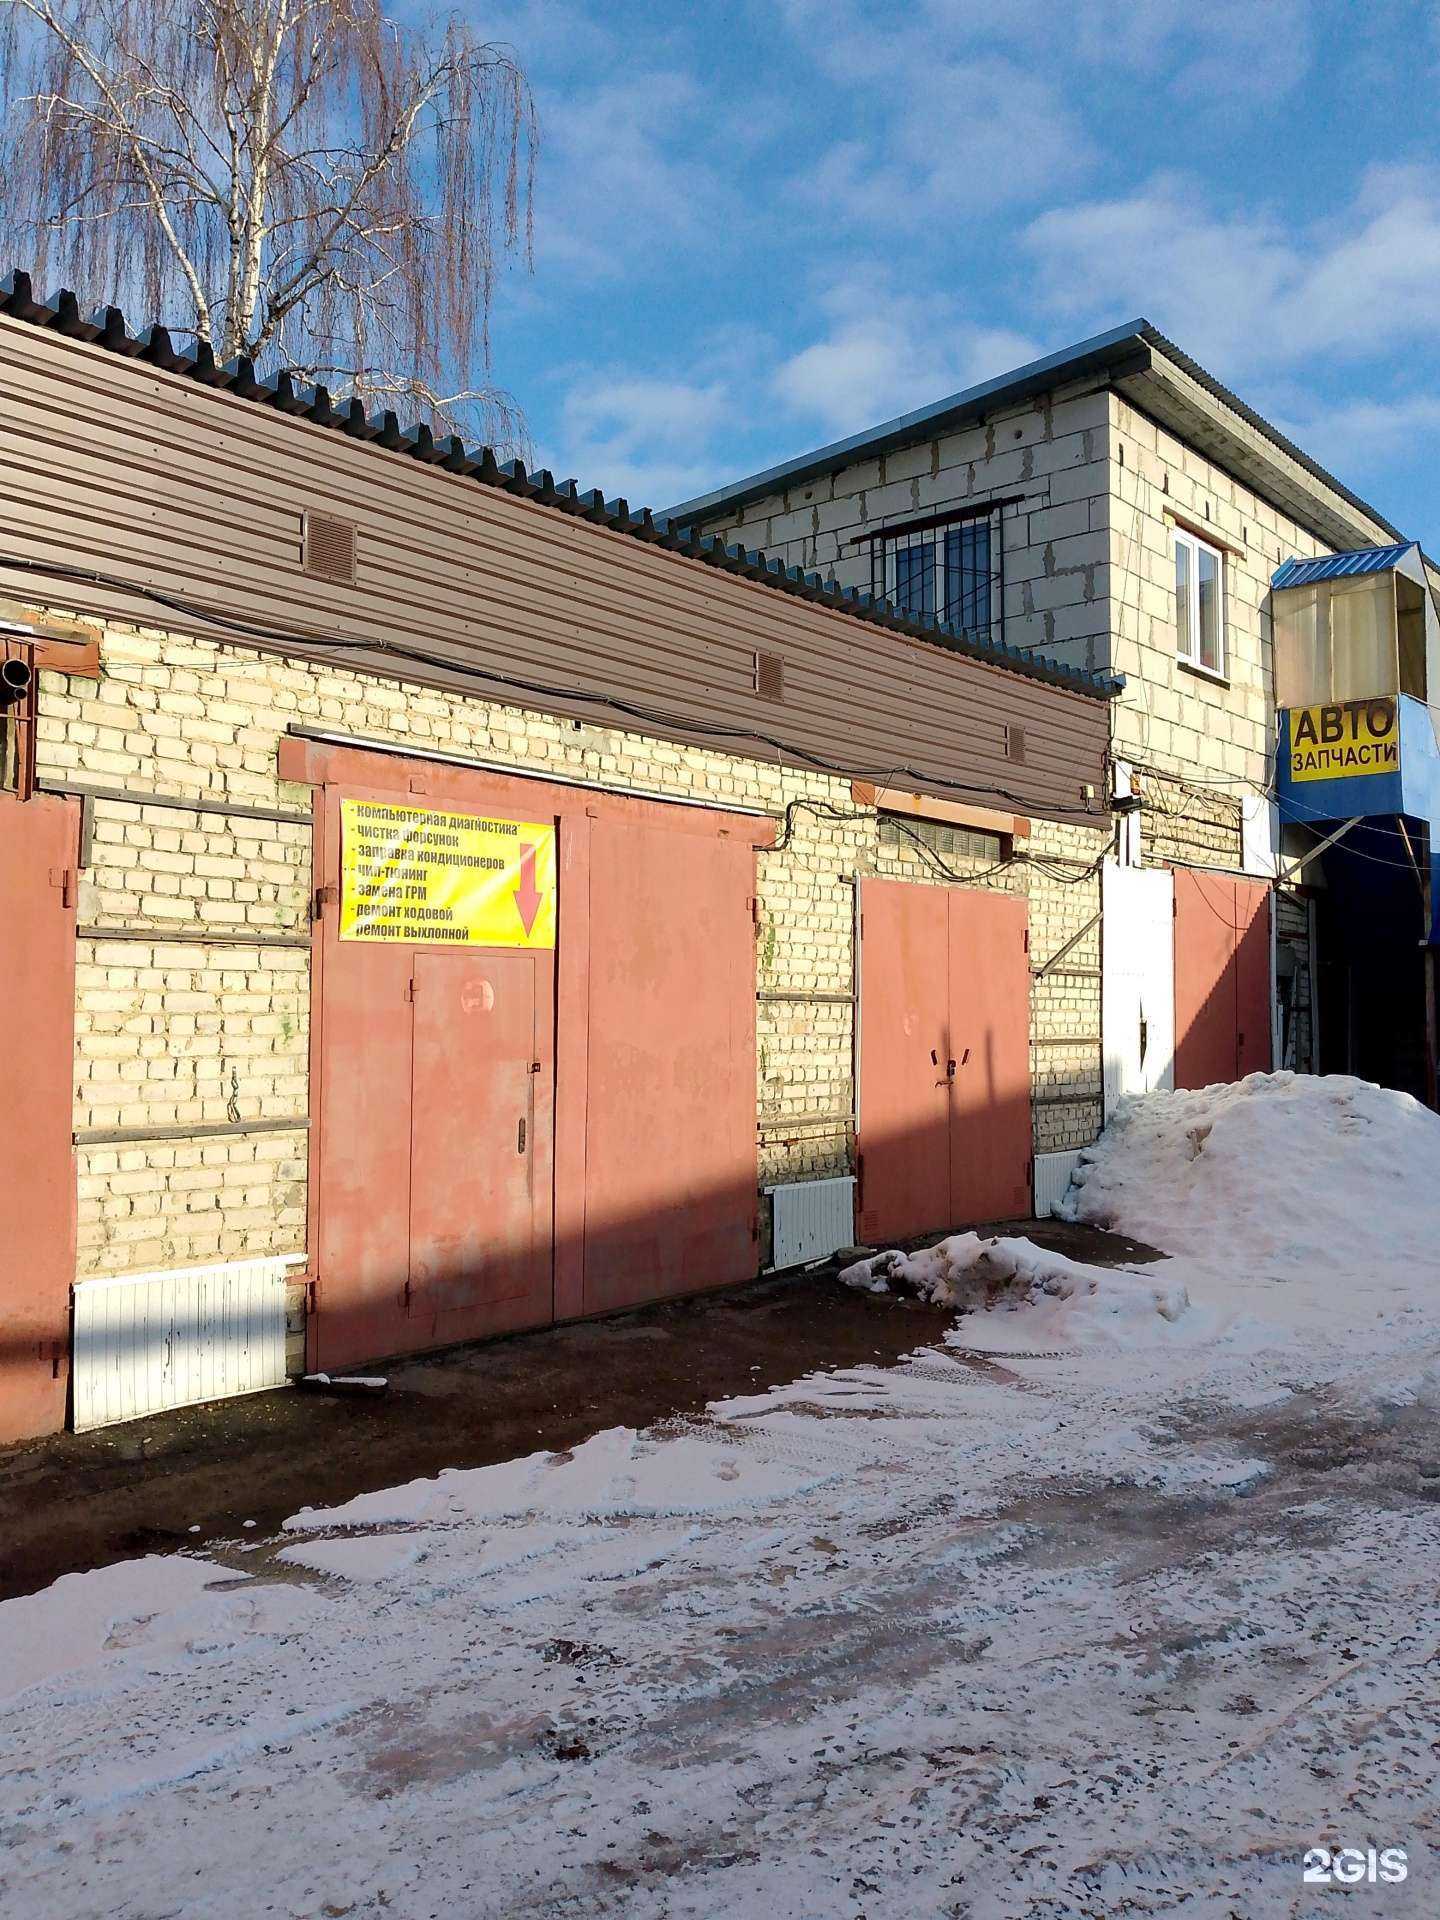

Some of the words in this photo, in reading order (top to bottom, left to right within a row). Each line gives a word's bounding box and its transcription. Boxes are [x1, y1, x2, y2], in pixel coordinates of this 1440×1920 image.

[1294, 700, 1394, 747] АВТО
[1293, 742, 1397, 772] ЗАПЧАСТИ
[357, 805, 447, 827] компьютерная
[449, 816, 518, 836] диагностика
[357, 825, 399, 840] чистка
[403, 829, 459, 847] форсунок
[417, 850, 505, 870] кондиционеров
[358, 884, 402, 898] замена
[405, 885, 427, 900] ГРМ
[356, 904, 401, 917] ремонт
[404, 906, 453, 921] ходовой
[356, 923, 401, 936] ремонт
[404, 926, 469, 940] выхлопной
